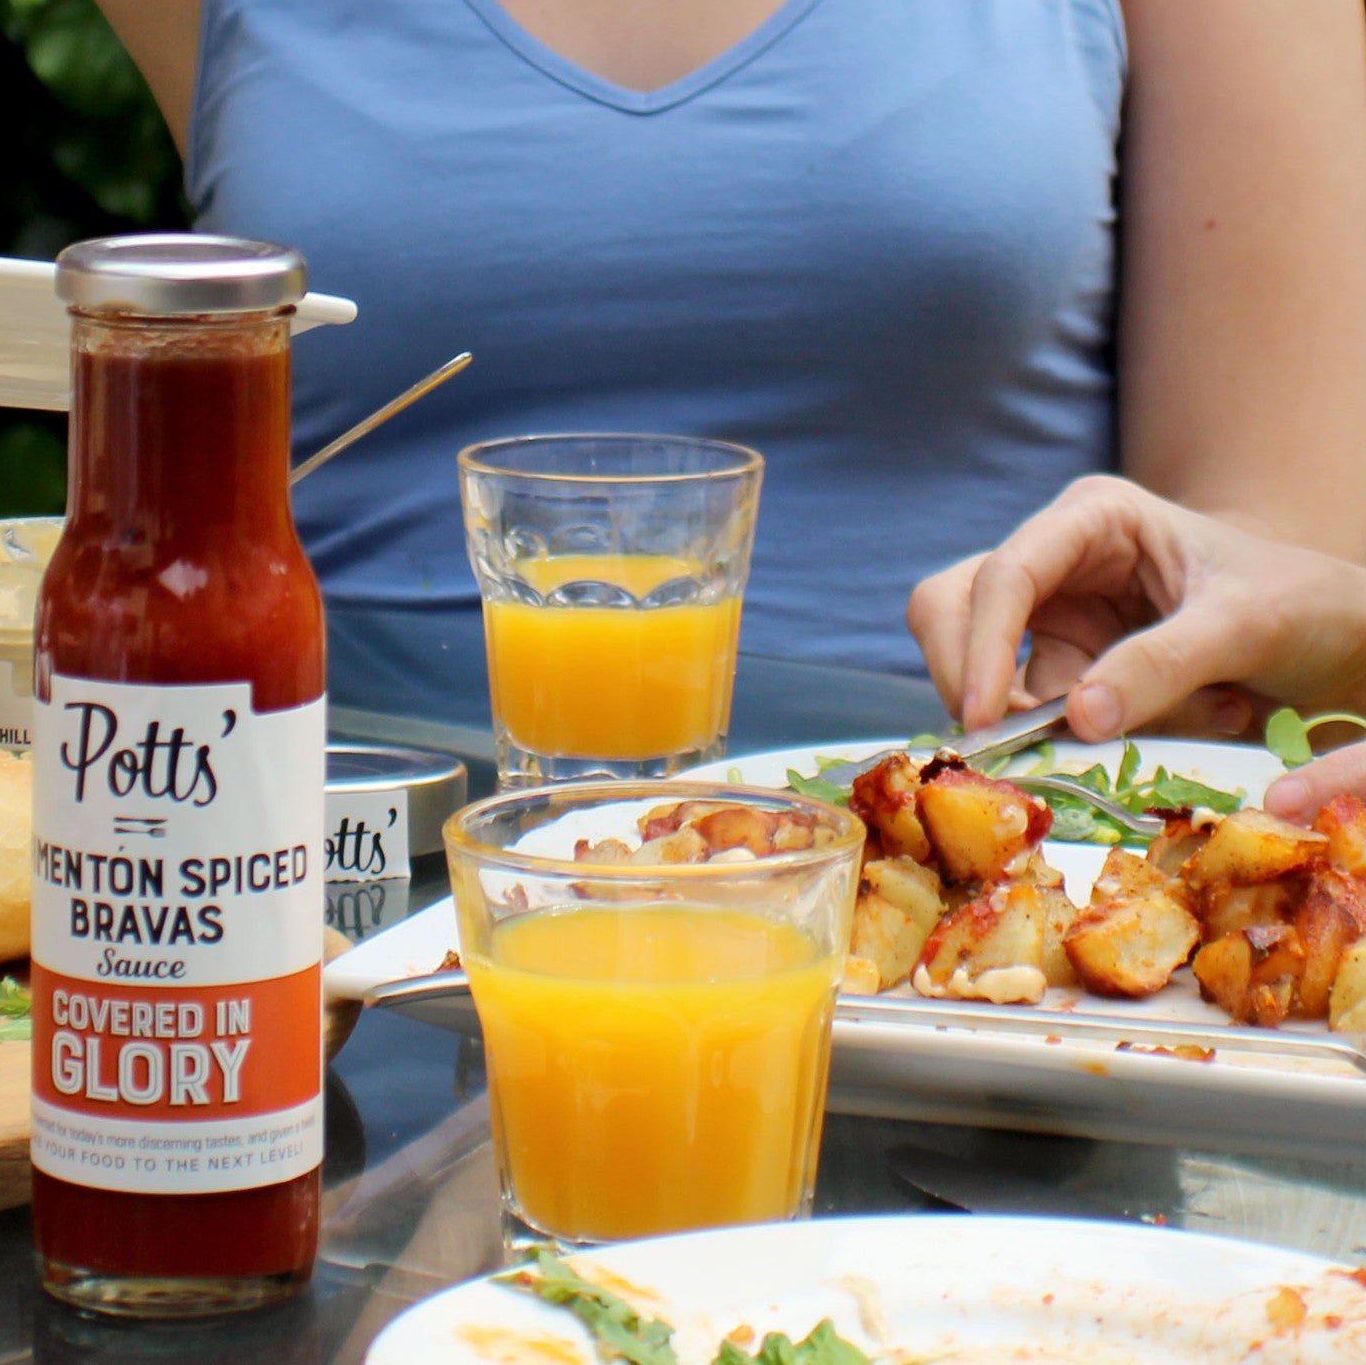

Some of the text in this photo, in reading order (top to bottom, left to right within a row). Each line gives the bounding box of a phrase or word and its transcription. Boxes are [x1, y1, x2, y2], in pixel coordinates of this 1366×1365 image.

[60, 701, 237, 807] Potts'
[178, 844, 308, 898] SPICED
[70, 898, 225, 945] BRAVAS
[96, 947, 187, 980] Sauce
[52, 989, 251, 1038] COVERED IN
[51, 1030, 252, 1106] GLORY
[81, 1150, 125, 1170] FOOD
[134, 1157, 156, 1172] TO
[165, 1157, 200, 1172] THE
[208, 1153, 253, 1170] NEXT
